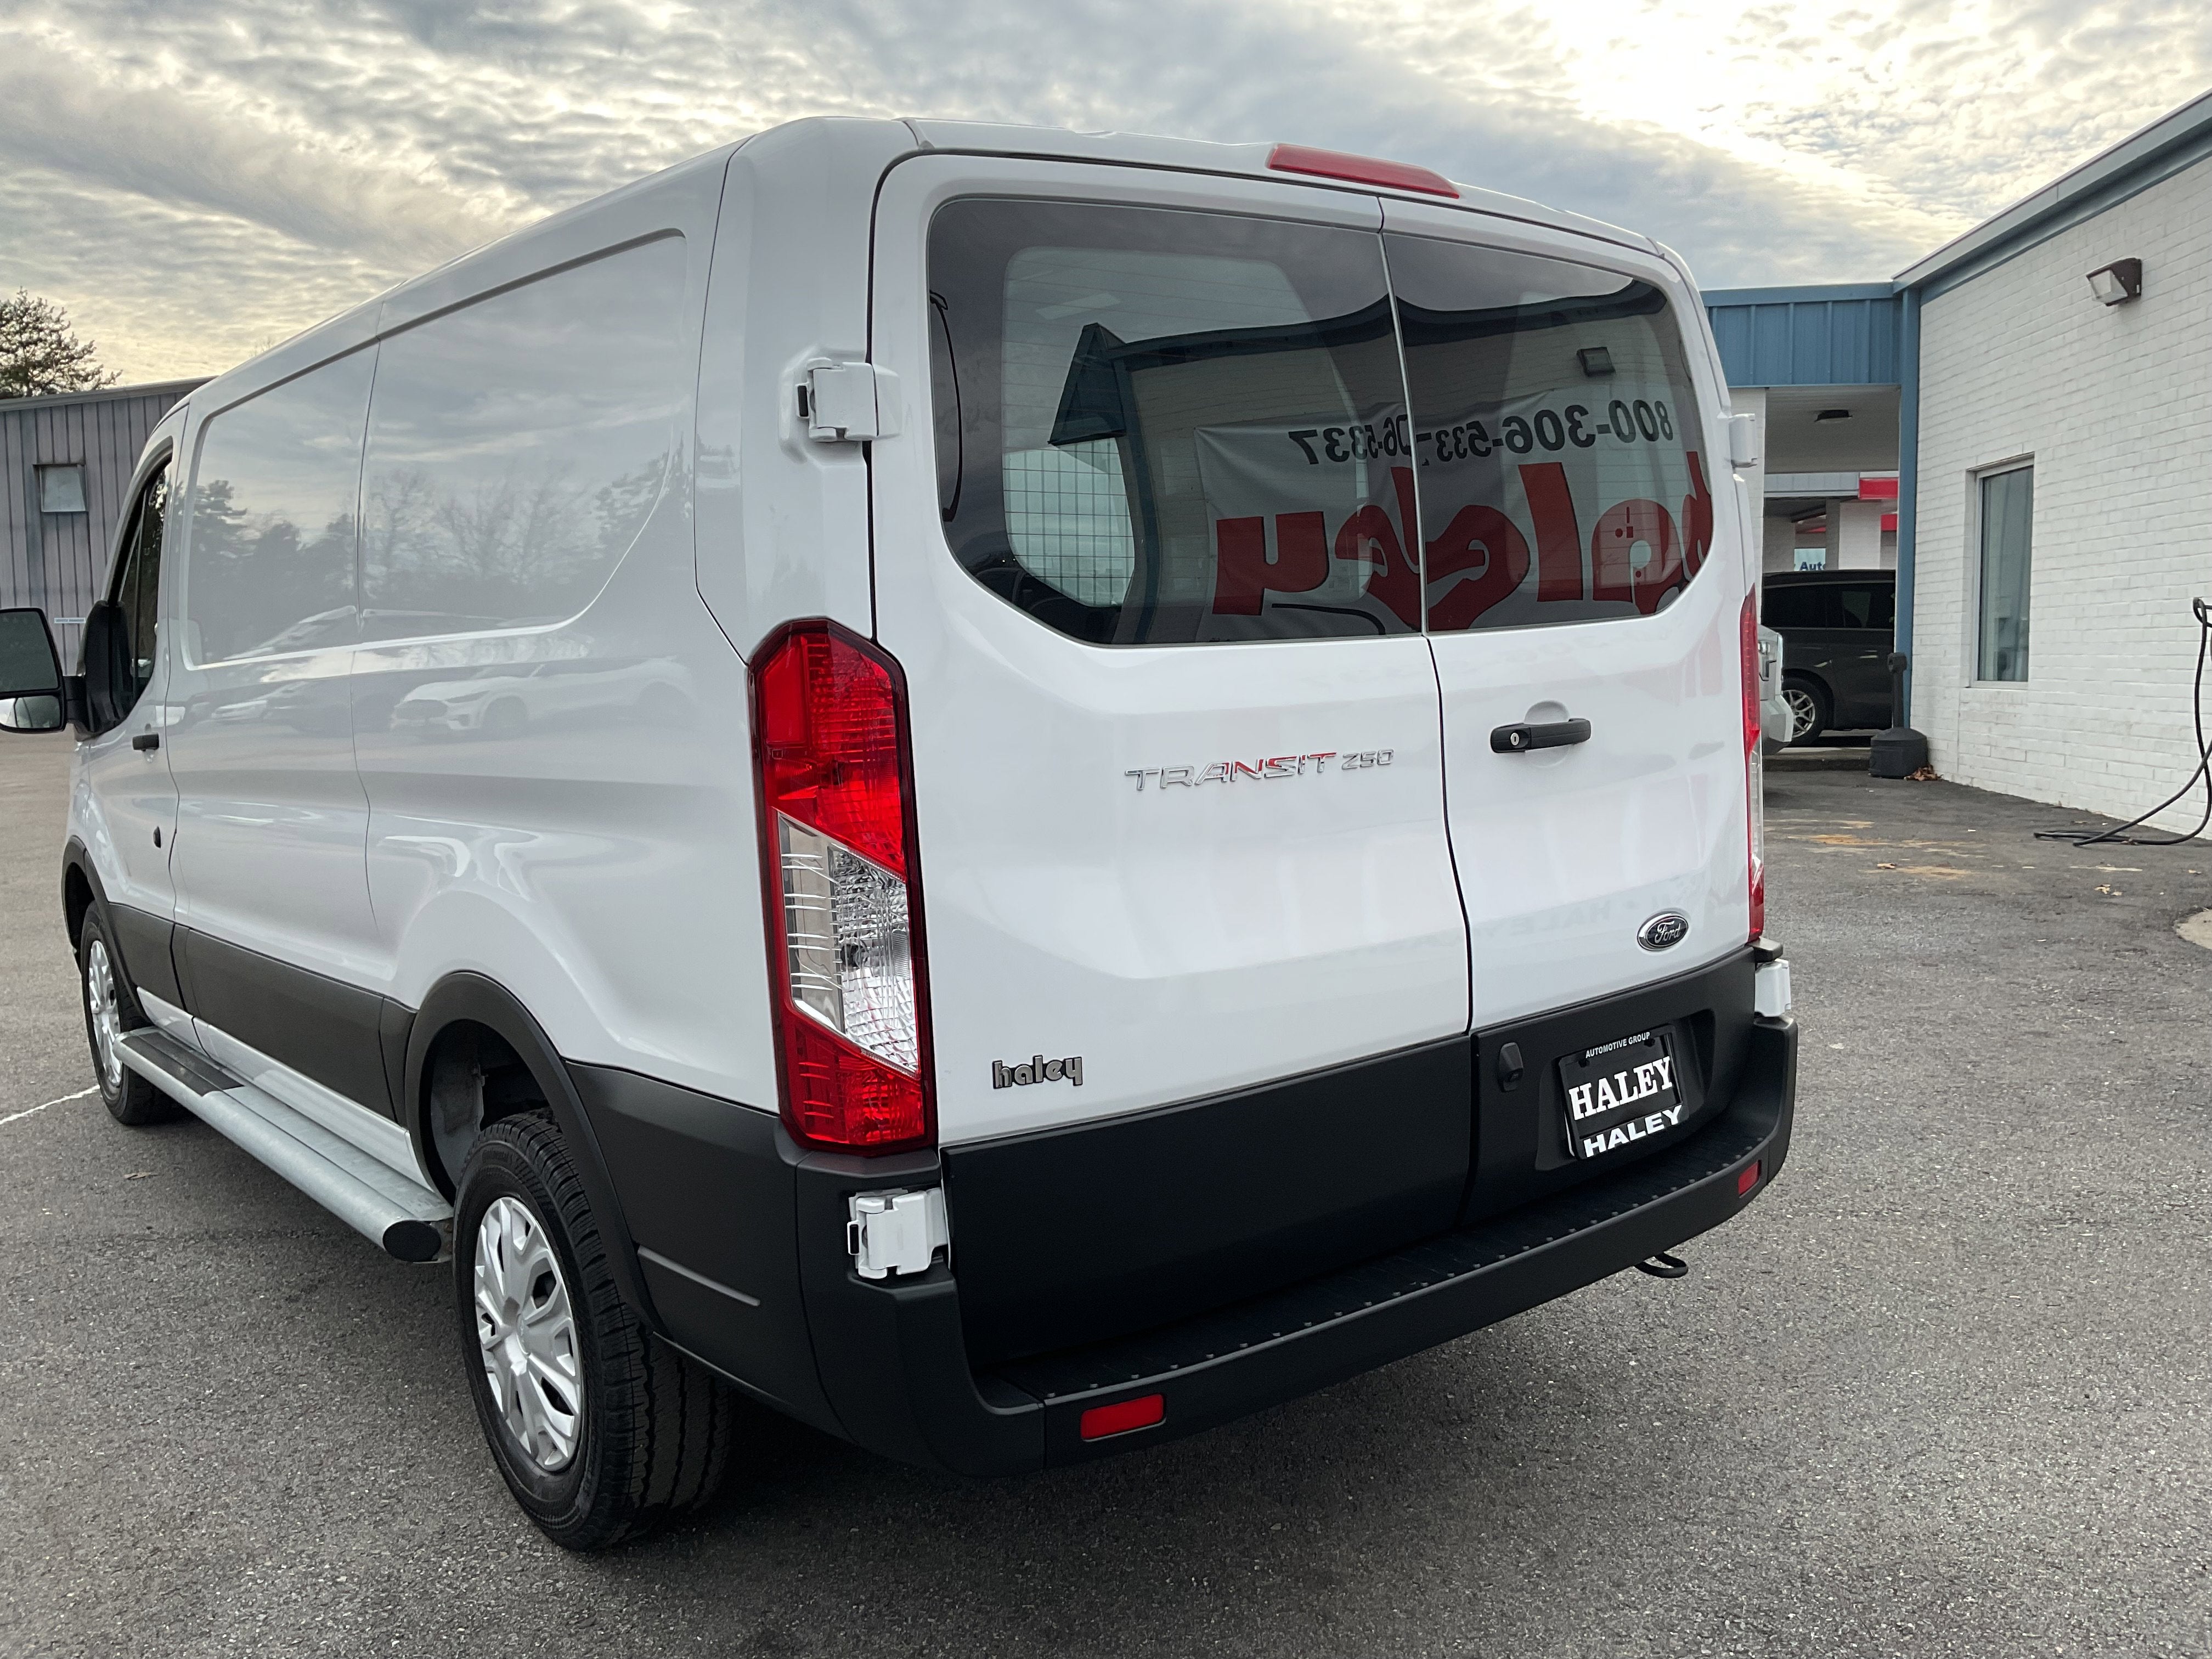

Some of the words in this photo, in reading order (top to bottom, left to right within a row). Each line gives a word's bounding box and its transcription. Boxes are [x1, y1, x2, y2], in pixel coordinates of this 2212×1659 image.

[1125, 752, 1337, 791] TRANSIT
[1342, 748, 1395, 770] 250
[1655, 920, 1681, 944] Ford
[1585, 1038, 1627, 1059] AUTOMOTIVE
[1628, 1031, 1651, 1045] GROUP
[992, 1054, 1083, 1089] haley
[1568, 1056, 1673, 1120] HALEY
[1583, 1104, 1682, 1158] HALEY
